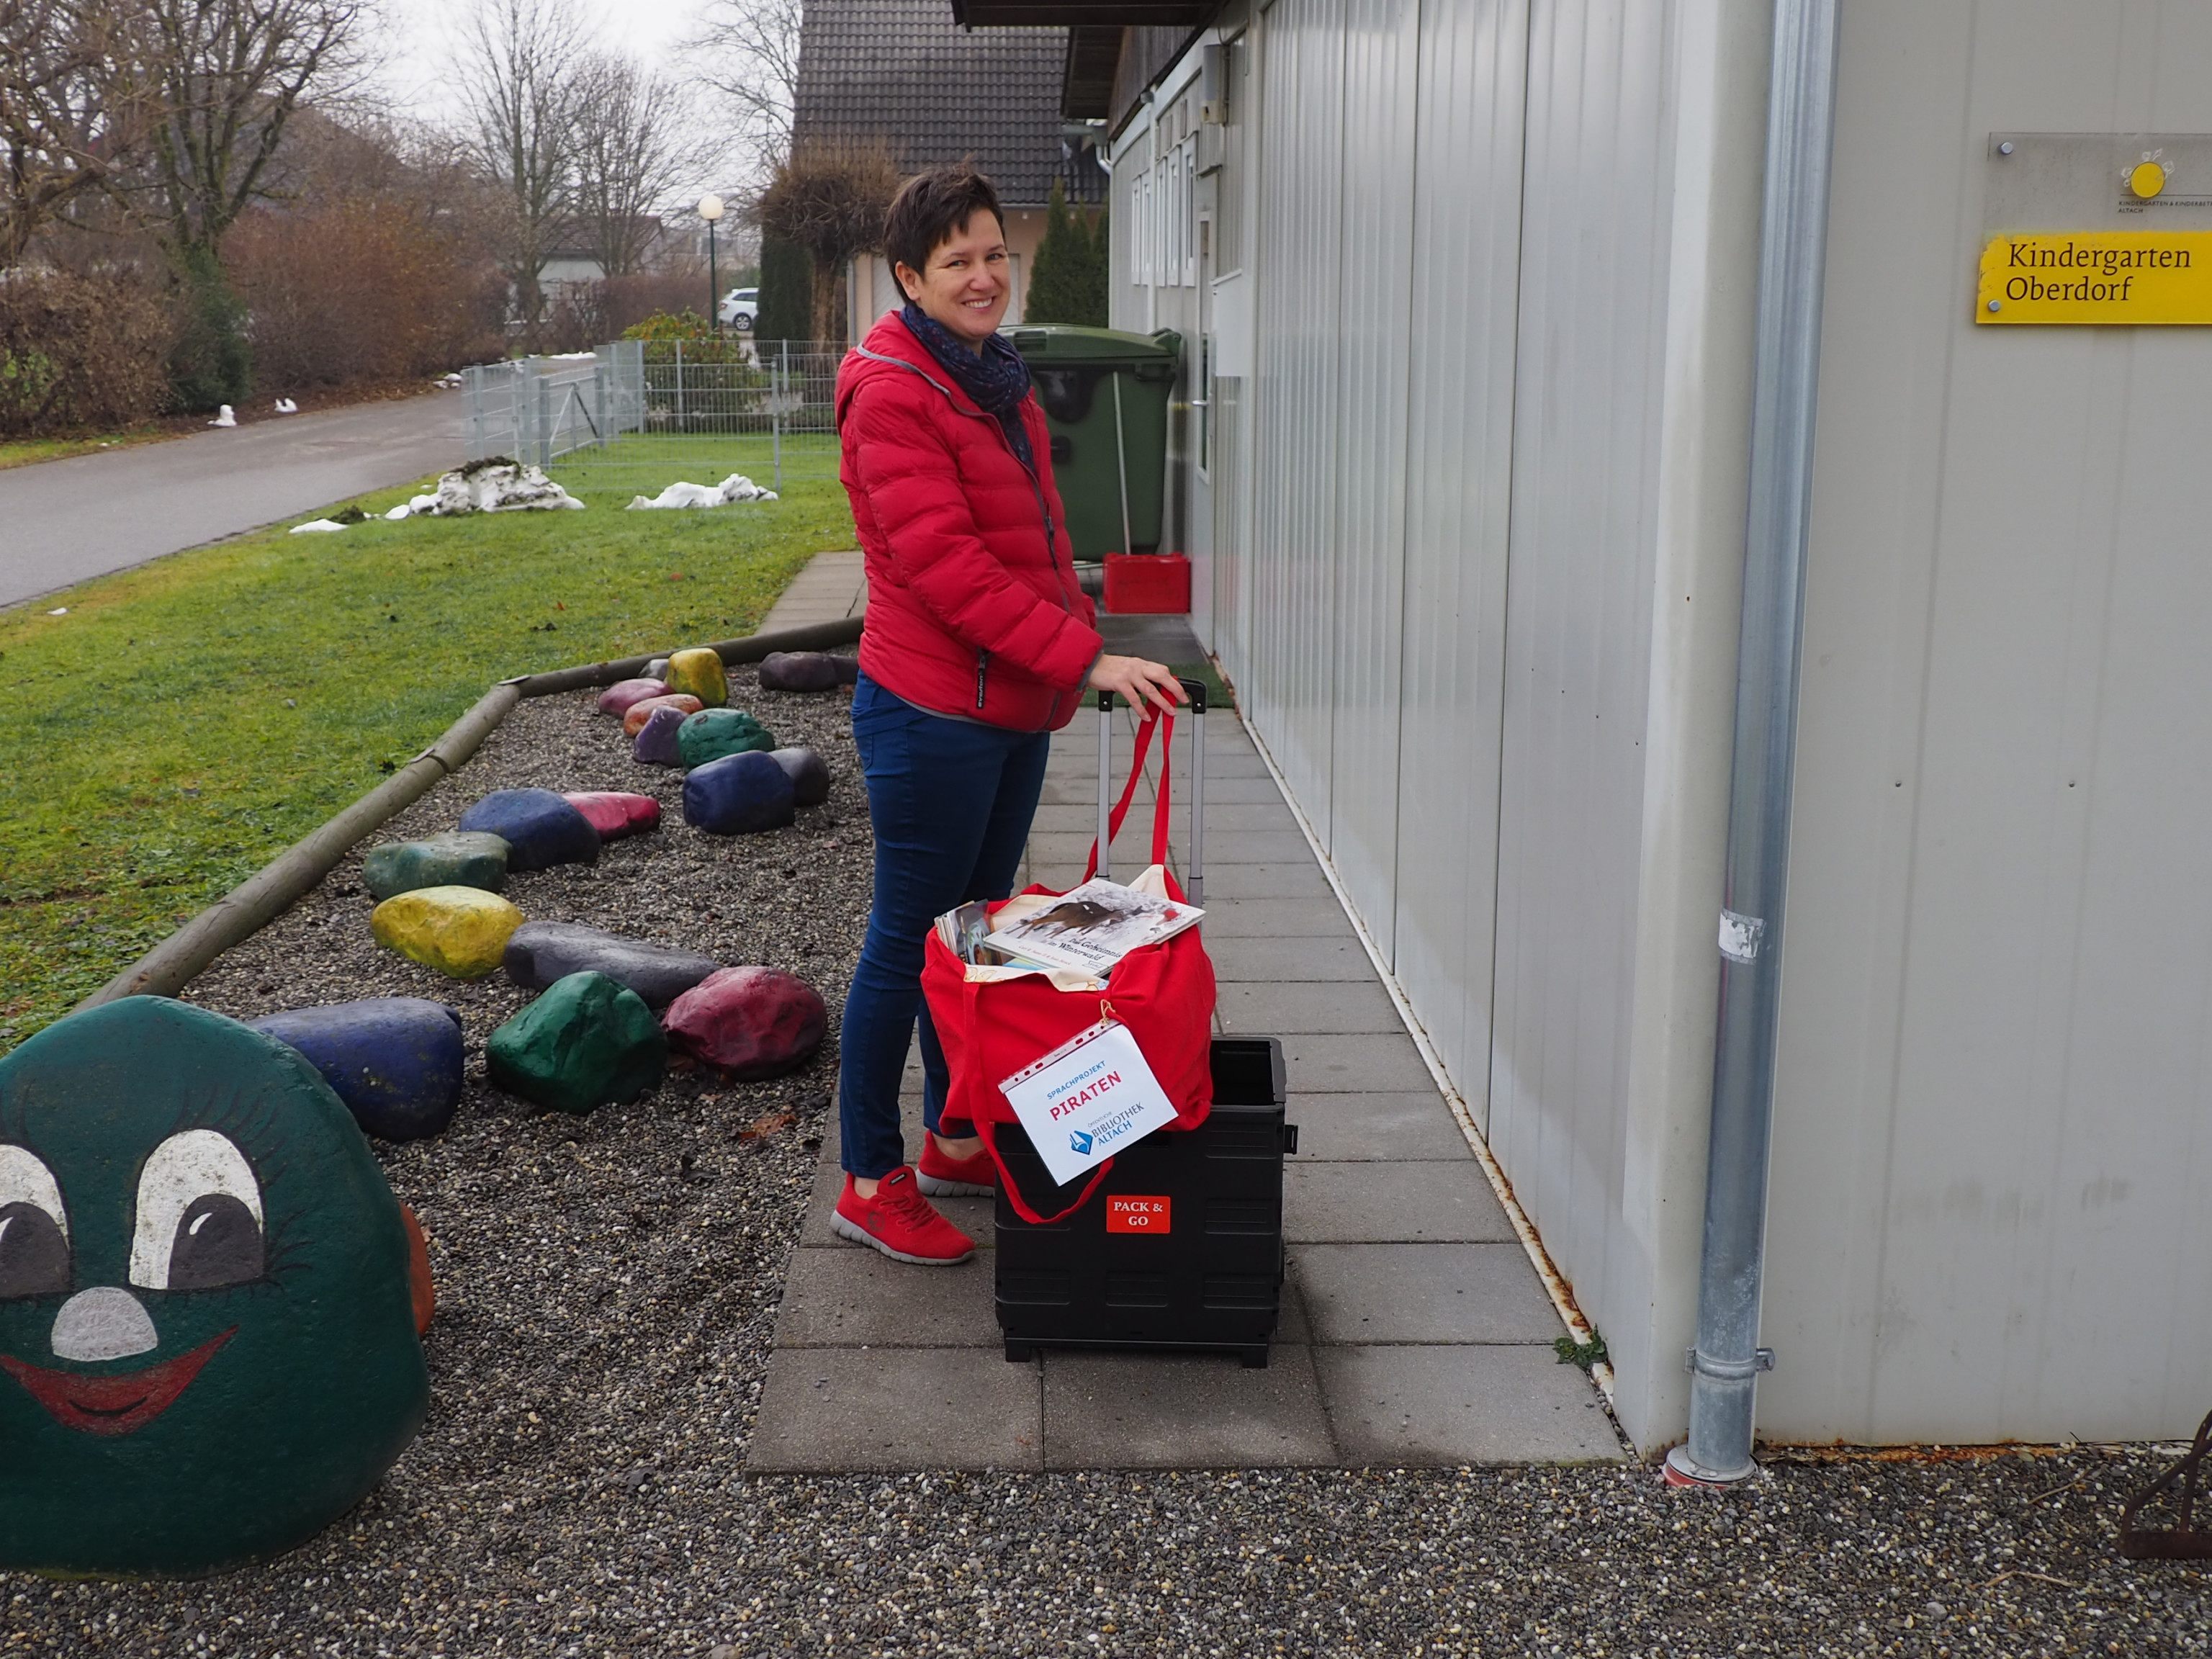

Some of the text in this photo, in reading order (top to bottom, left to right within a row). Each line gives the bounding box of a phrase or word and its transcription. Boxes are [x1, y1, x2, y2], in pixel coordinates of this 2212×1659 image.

[2008, 242, 2191, 276] Kindergarten
[2006, 276, 2134, 301] Oberdorf
[1058, 943, 1105, 961] Winterwald
[1047, 1061, 1106, 1100] SPRACHPROJEKT
[1049, 1070, 1122, 1121] PIRATEN
[1092, 1102, 1145, 1138] BIBLIOTHEK
[1098, 1120, 1133, 1146] ALTACH
[1113, 1202, 1163, 1212] PACK &
[1128, 1216, 1148, 1226] GO
